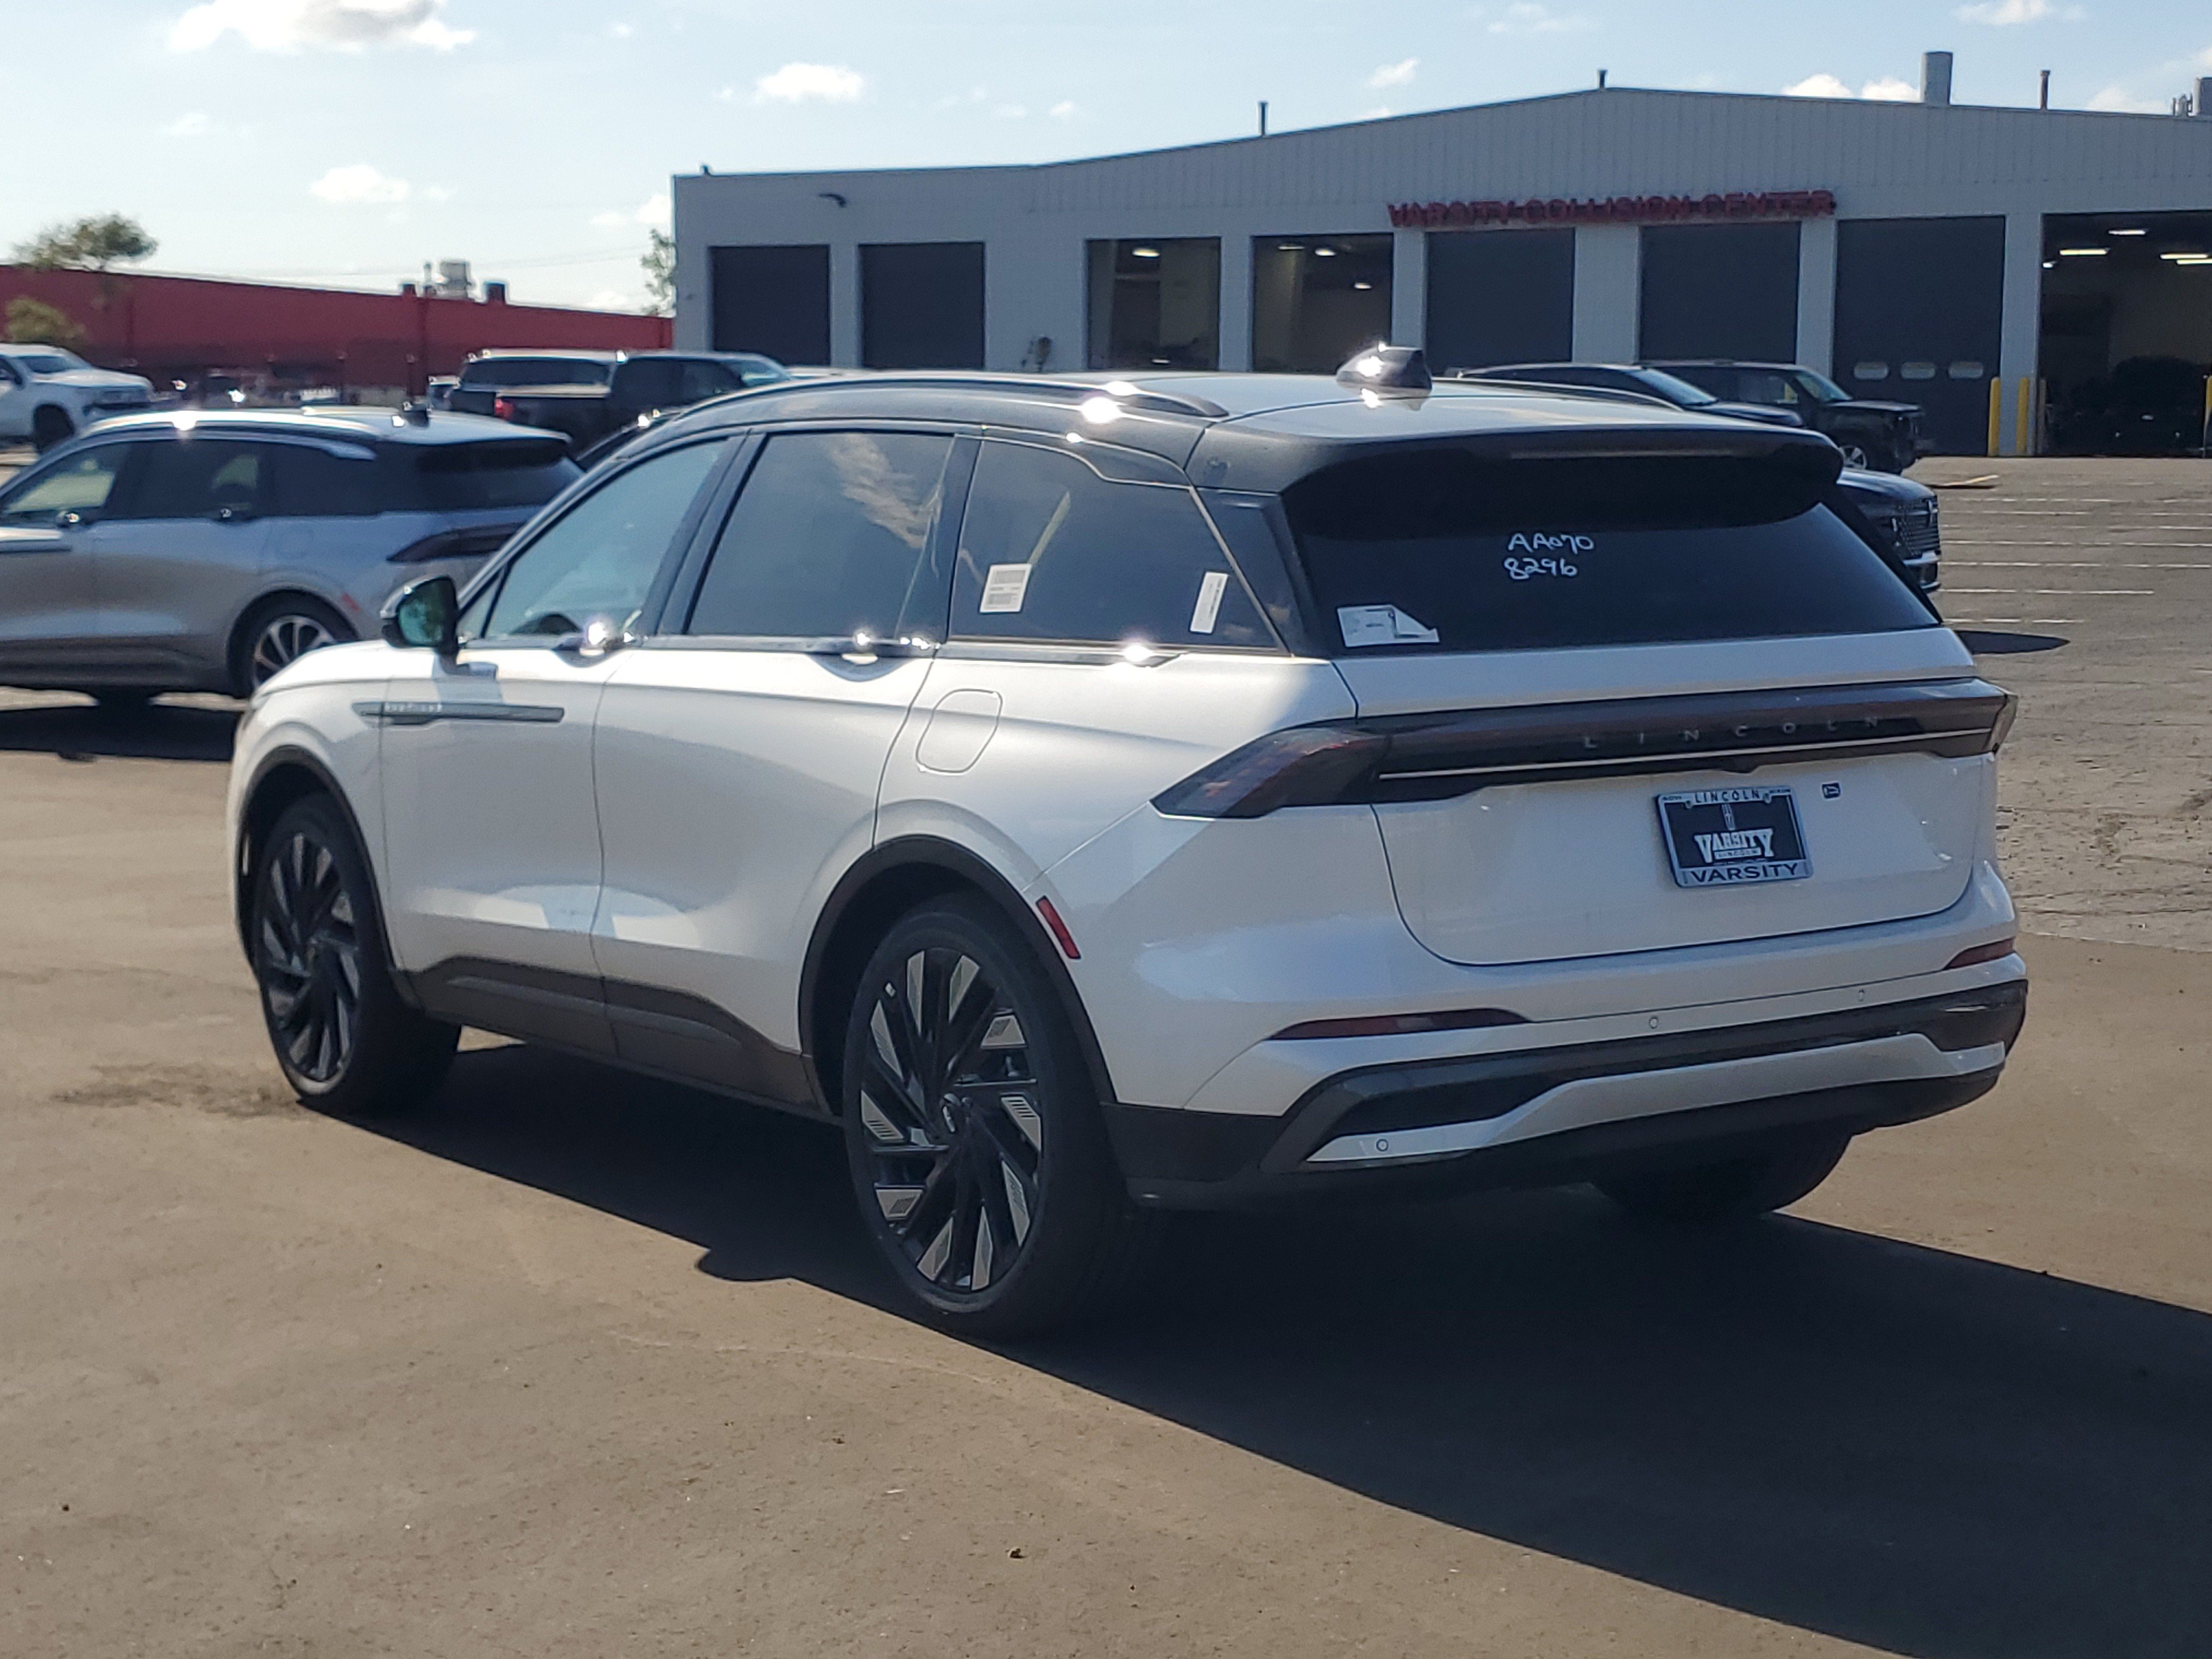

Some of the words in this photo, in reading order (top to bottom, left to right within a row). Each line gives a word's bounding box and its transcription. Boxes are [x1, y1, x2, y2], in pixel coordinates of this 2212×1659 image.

[1523, 195, 1690, 224] COLLISION
[1702, 190, 1836, 216] CENTER
[1504, 557, 1578, 579] 8296
[1583, 716, 1878, 749] LINCOLN
[1695, 789, 1760, 803] LINCOLN
[1694, 828, 1775, 863] VARSITY
[1690, 863, 1798, 882] VARSITY
